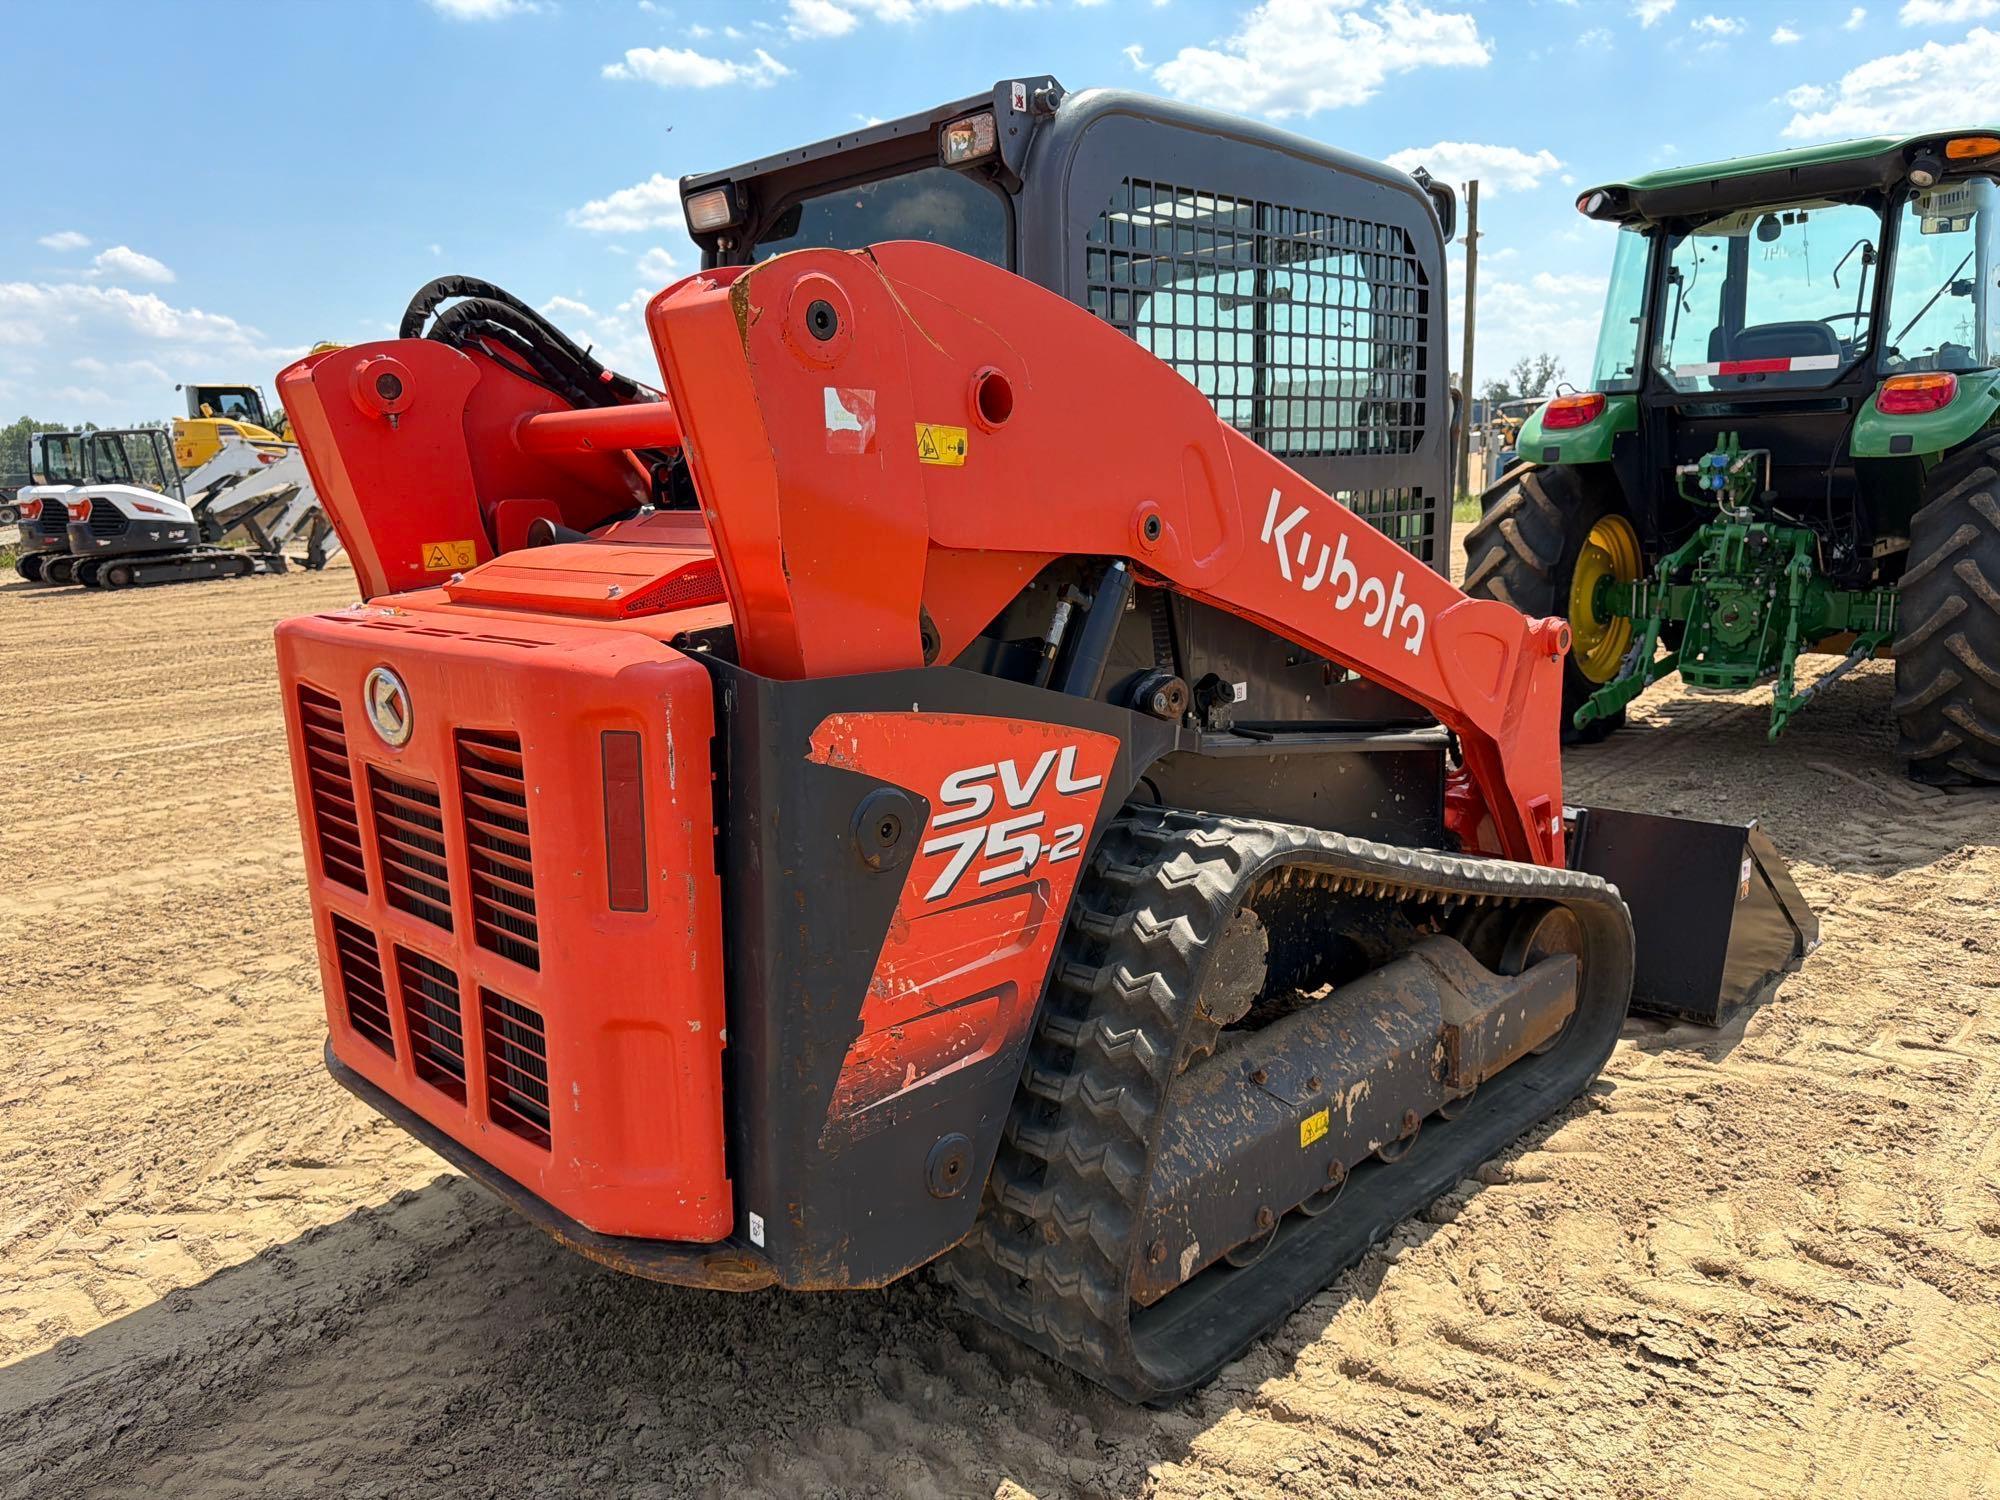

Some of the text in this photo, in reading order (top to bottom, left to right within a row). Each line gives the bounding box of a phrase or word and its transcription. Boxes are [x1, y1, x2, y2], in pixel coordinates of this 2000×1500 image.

[1260, 487, 1425, 656] Kubota
[931, 745, 1102, 829] SVL
[921, 810, 1085, 903] 75-2
